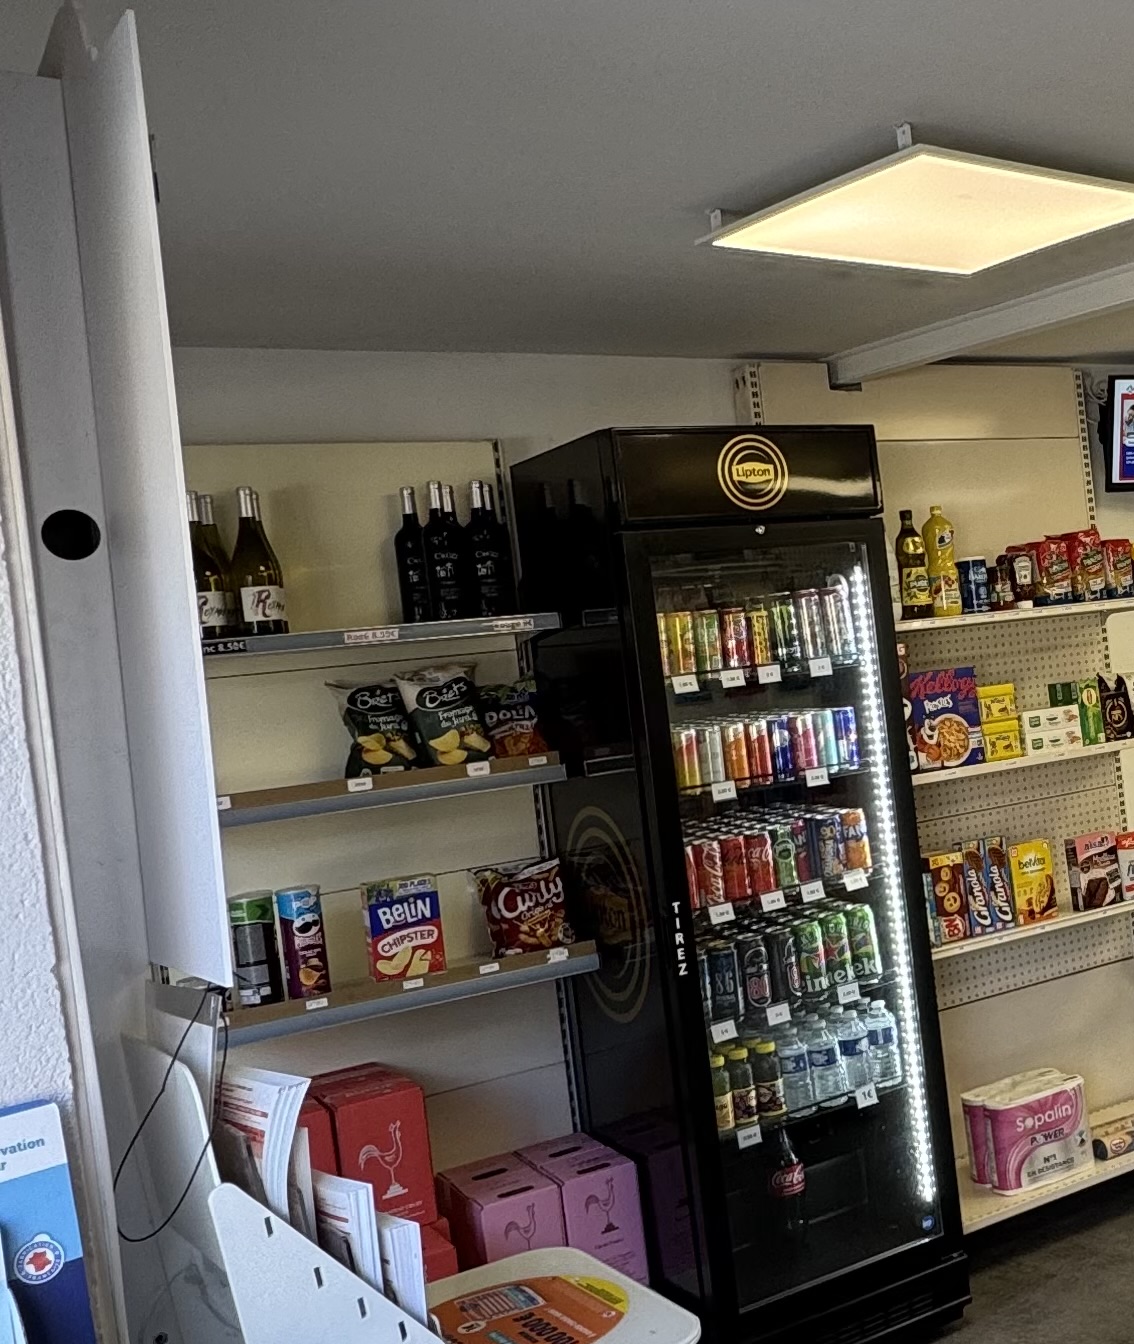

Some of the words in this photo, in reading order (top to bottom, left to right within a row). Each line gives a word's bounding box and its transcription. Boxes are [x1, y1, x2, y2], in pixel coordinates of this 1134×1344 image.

[736, 466, 771, 480] Lipton
[1017, 855, 1046, 871] belvita
[498, 877, 565, 918] Curly
[970, 868, 992, 927] Granola
[990, 864, 1013, 922] Granola
[672, 901, 688, 976] TIREZ
[942, 916, 960, 940] BN
[380, 929, 436, 954] CHIPSTER
[861, 1090, 874, 1101] 1€
[1015, 1101, 1072, 1133] Sopalin
[1030, 1126, 1066, 1146] POWER
